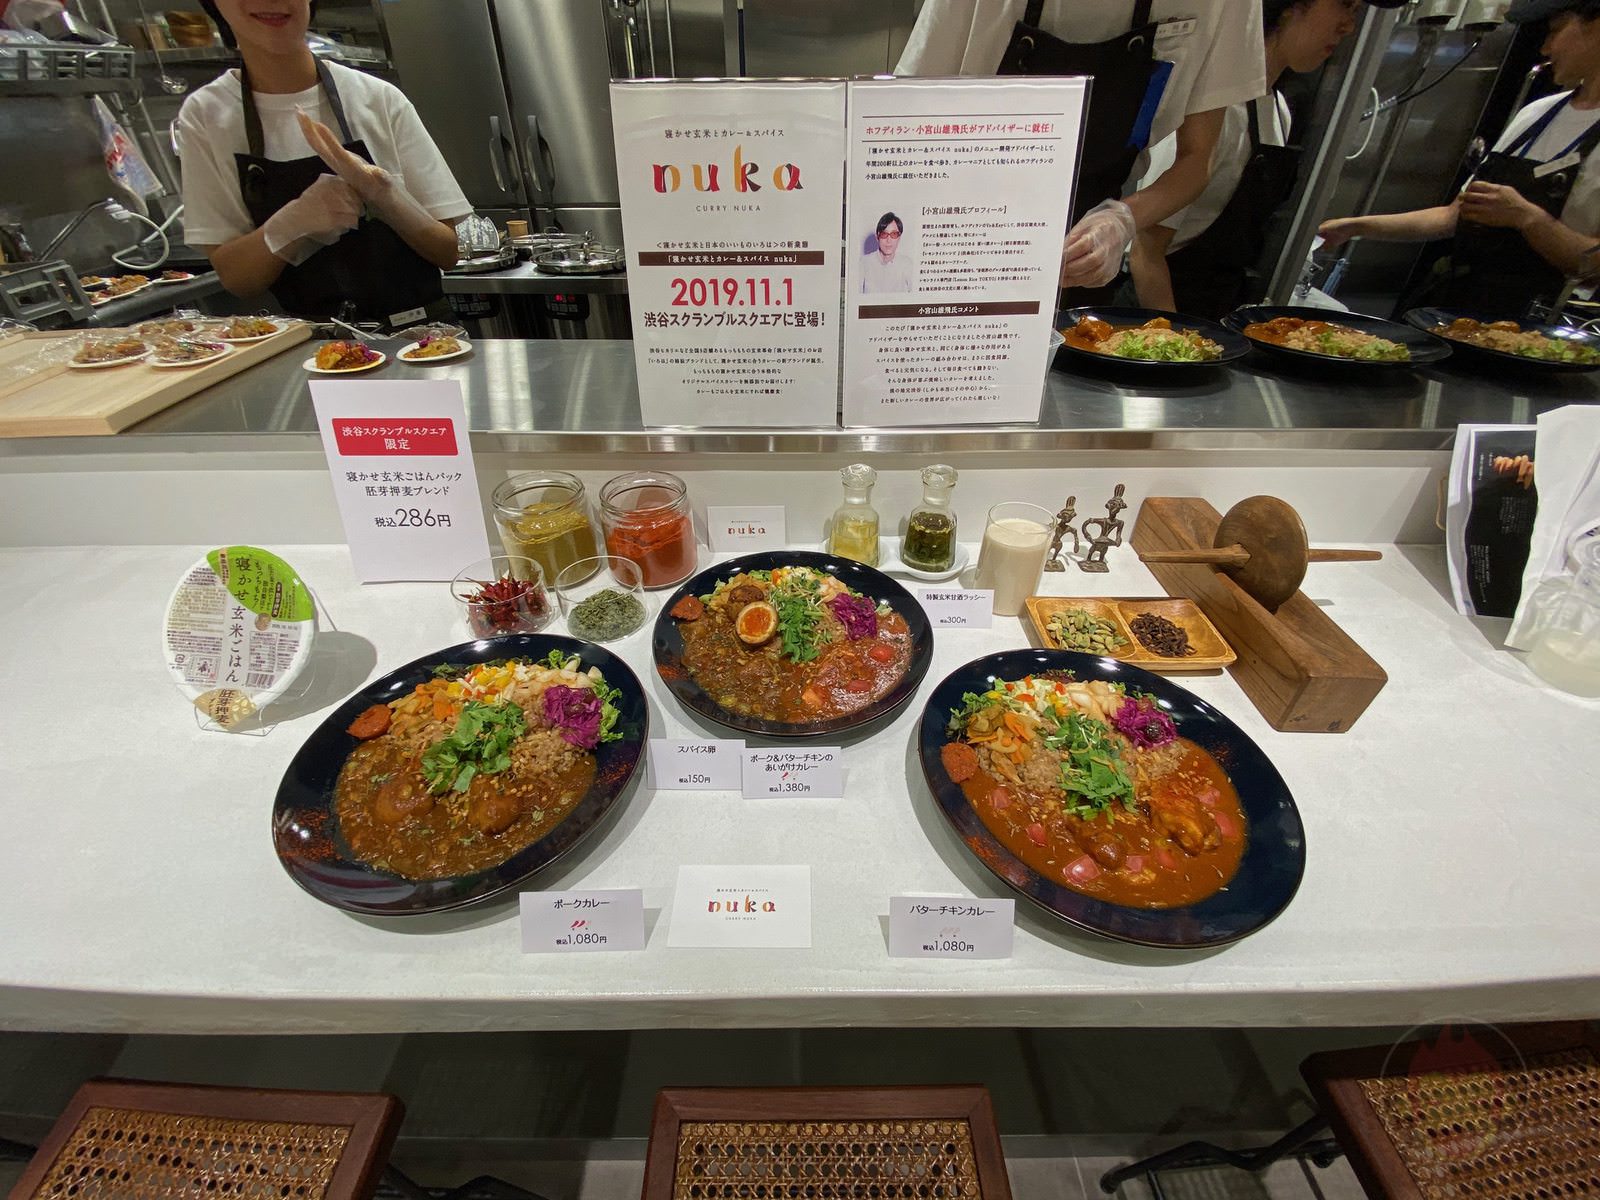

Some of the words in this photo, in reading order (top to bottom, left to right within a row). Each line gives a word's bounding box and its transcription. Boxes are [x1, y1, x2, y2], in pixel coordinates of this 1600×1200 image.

[652, 144, 804, 193] nuka
[671, 278, 793, 306] 2019.11.1
[342, 426, 447, 437] 渋谷スクランブルスクエア
[384, 438, 411, 450] 限定
[346, 471, 462, 482] 寝かせ玄米ごはんパック
[365, 486, 450, 497] 胚芽押麦ブレンド
[374, 508, 451, 528] 税込286円
[728, 524, 766, 534] nuka
[678, 744, 716, 754] スパイス卵
[750, 754, 833, 763] ポーク&バターチキンの
[764, 763, 818, 772] あいがけカレー
[678, 774, 711, 784] 税込150円
[768, 783, 811, 792] 税込1,380円
[553, 898, 610, 910] ポークカレー
[708, 894, 776, 913] nuka
[910, 904, 996, 916] バターチキンカレー
[556, 933, 608, 946] 税込1,080円
[922, 940, 974, 952] 税込1,080円
